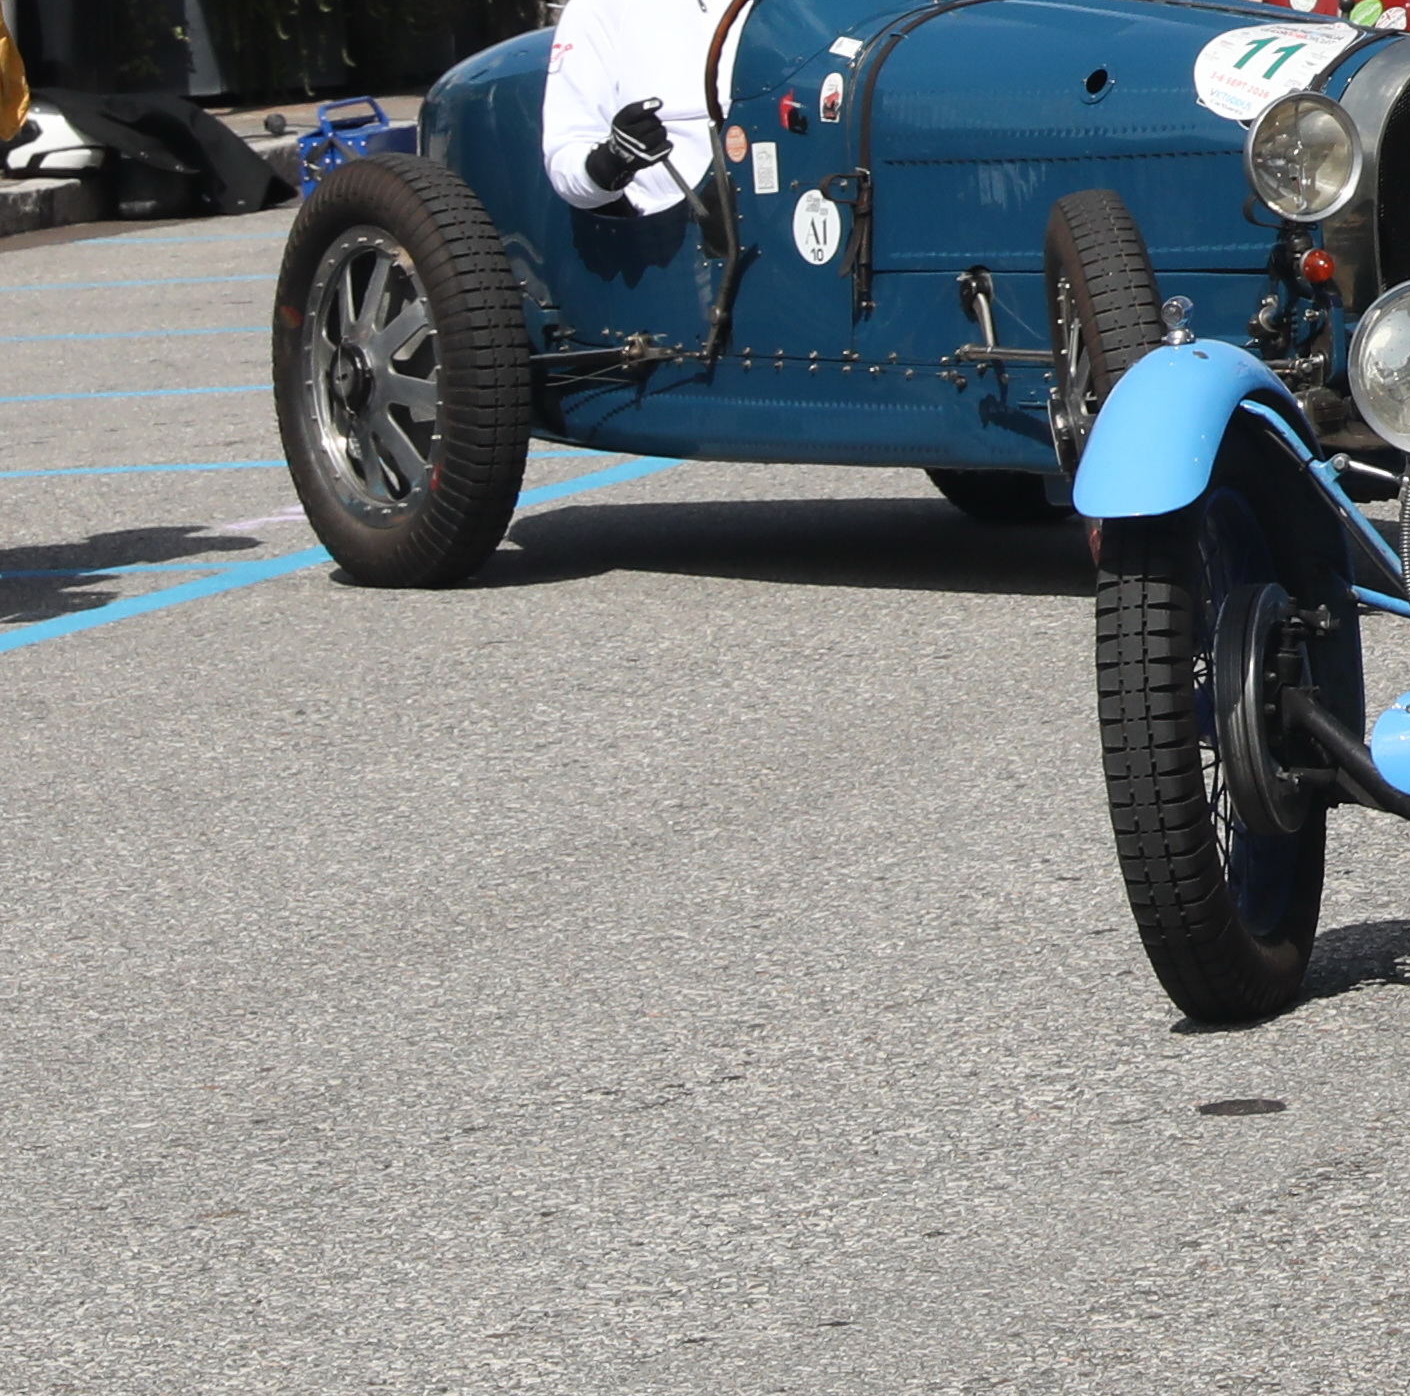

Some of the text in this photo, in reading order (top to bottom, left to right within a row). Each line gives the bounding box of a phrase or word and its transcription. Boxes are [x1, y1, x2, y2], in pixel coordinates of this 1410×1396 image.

[1233, 36, 1307, 80] 11
[1225, 76, 1248, 90] SEPT
[805, 217, 828, 245] A1
[810, 248, 824, 261] 10
